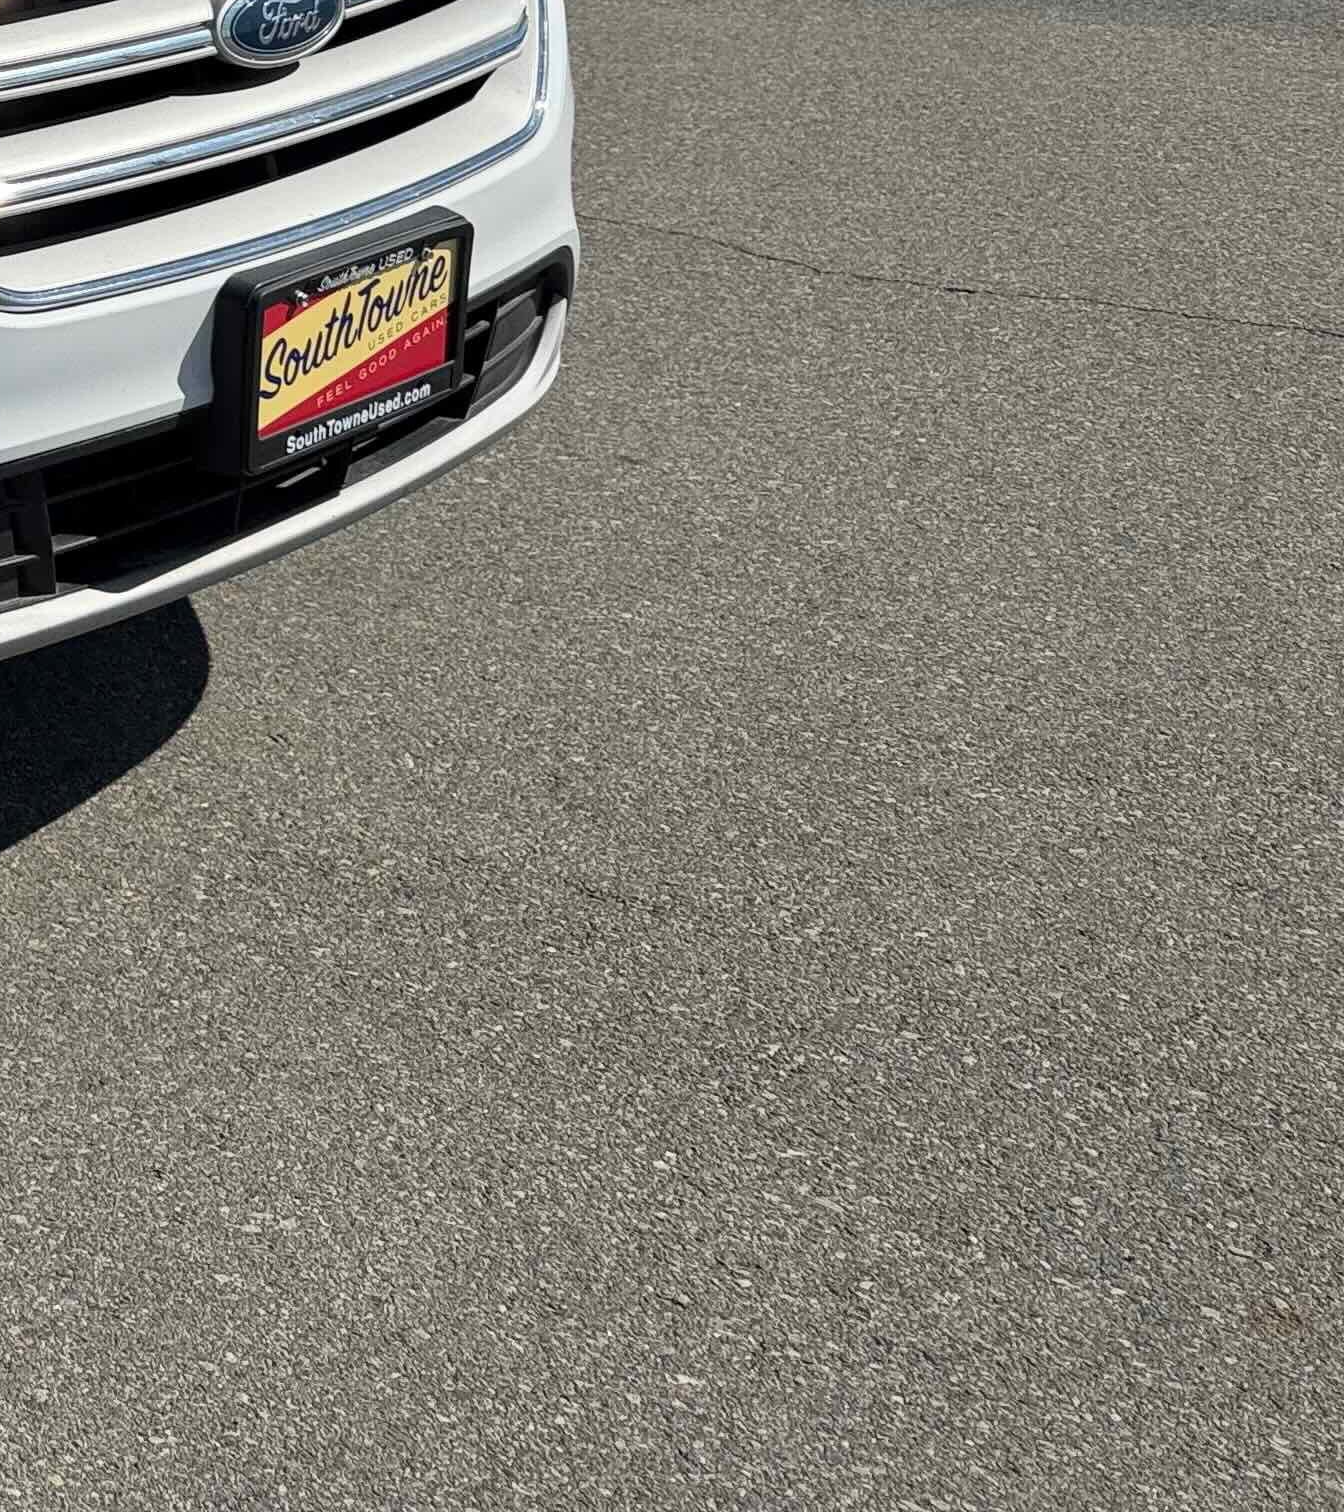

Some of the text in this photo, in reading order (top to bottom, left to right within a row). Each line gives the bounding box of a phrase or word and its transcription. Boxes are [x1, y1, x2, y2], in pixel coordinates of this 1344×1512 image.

[378, 247, 414, 270] USED
[368, 322, 404, 351] USED
[317, 382, 353, 408] FEEL
[359, 349, 397, 380] GOOD
[286, 383, 432, 454] SouthTowneUsed.com
